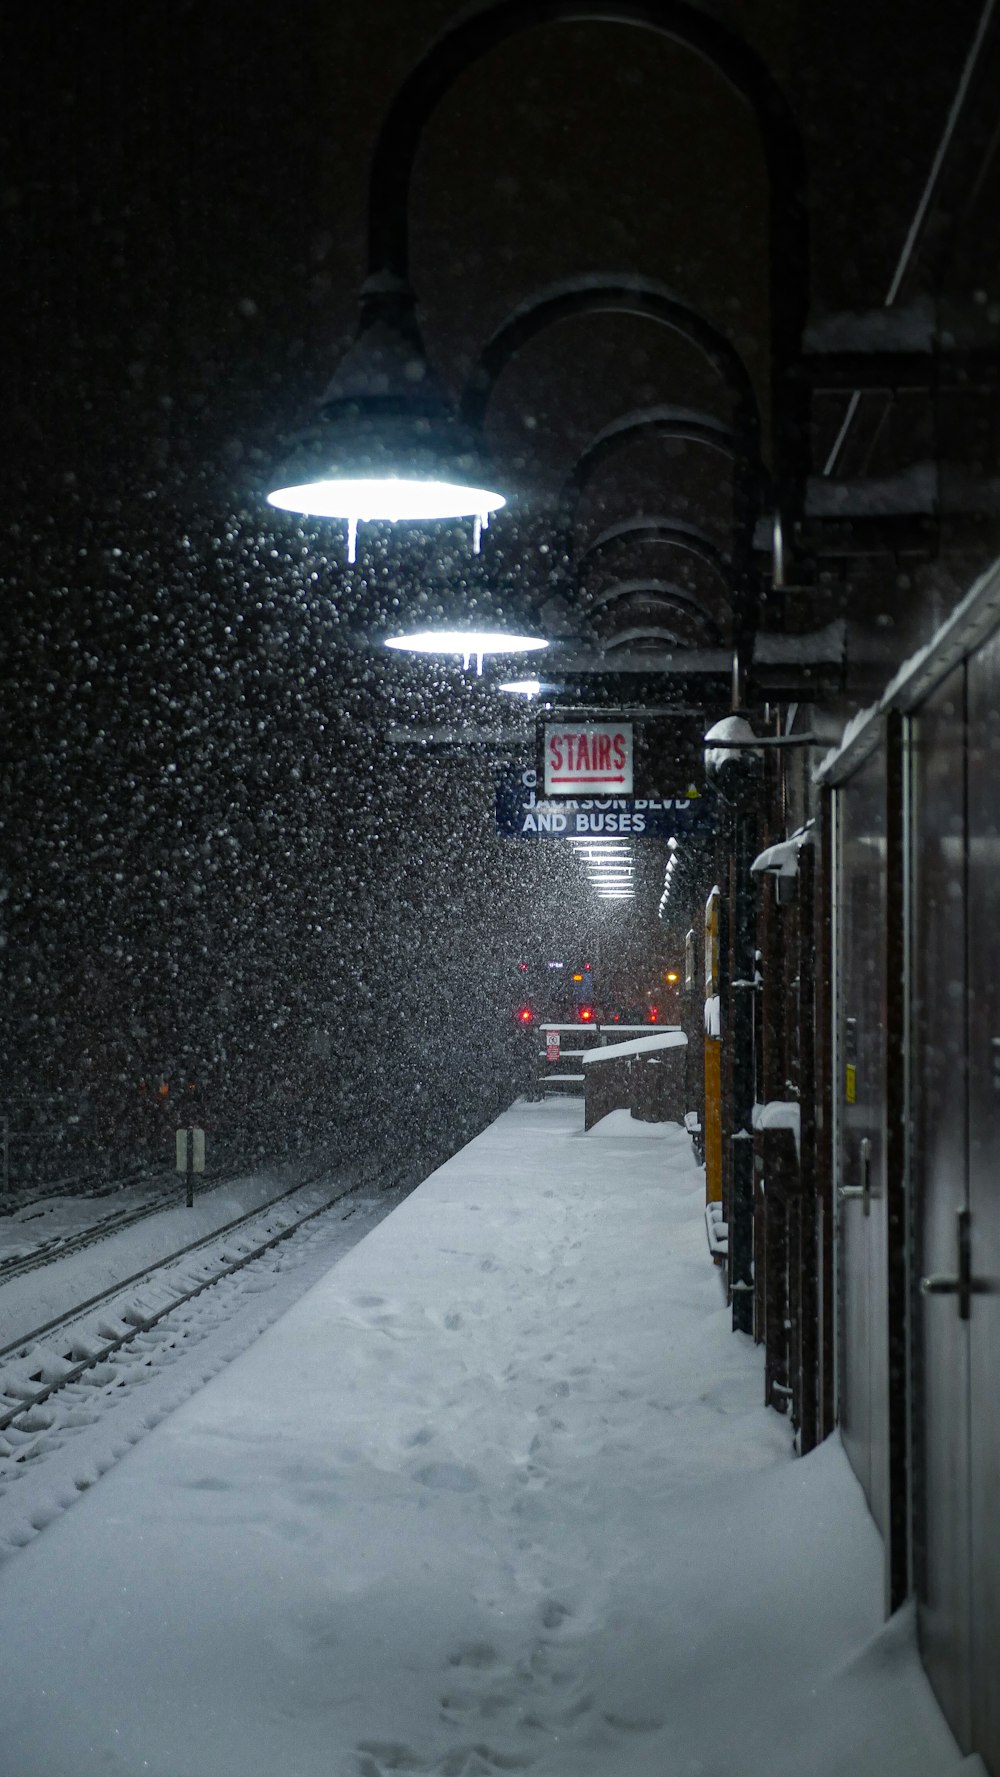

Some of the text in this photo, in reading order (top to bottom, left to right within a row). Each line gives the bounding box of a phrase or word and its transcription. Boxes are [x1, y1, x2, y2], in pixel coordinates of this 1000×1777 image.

[549, 733, 627, 771] STAIRS
[522, 813, 646, 832] AND BUSES
